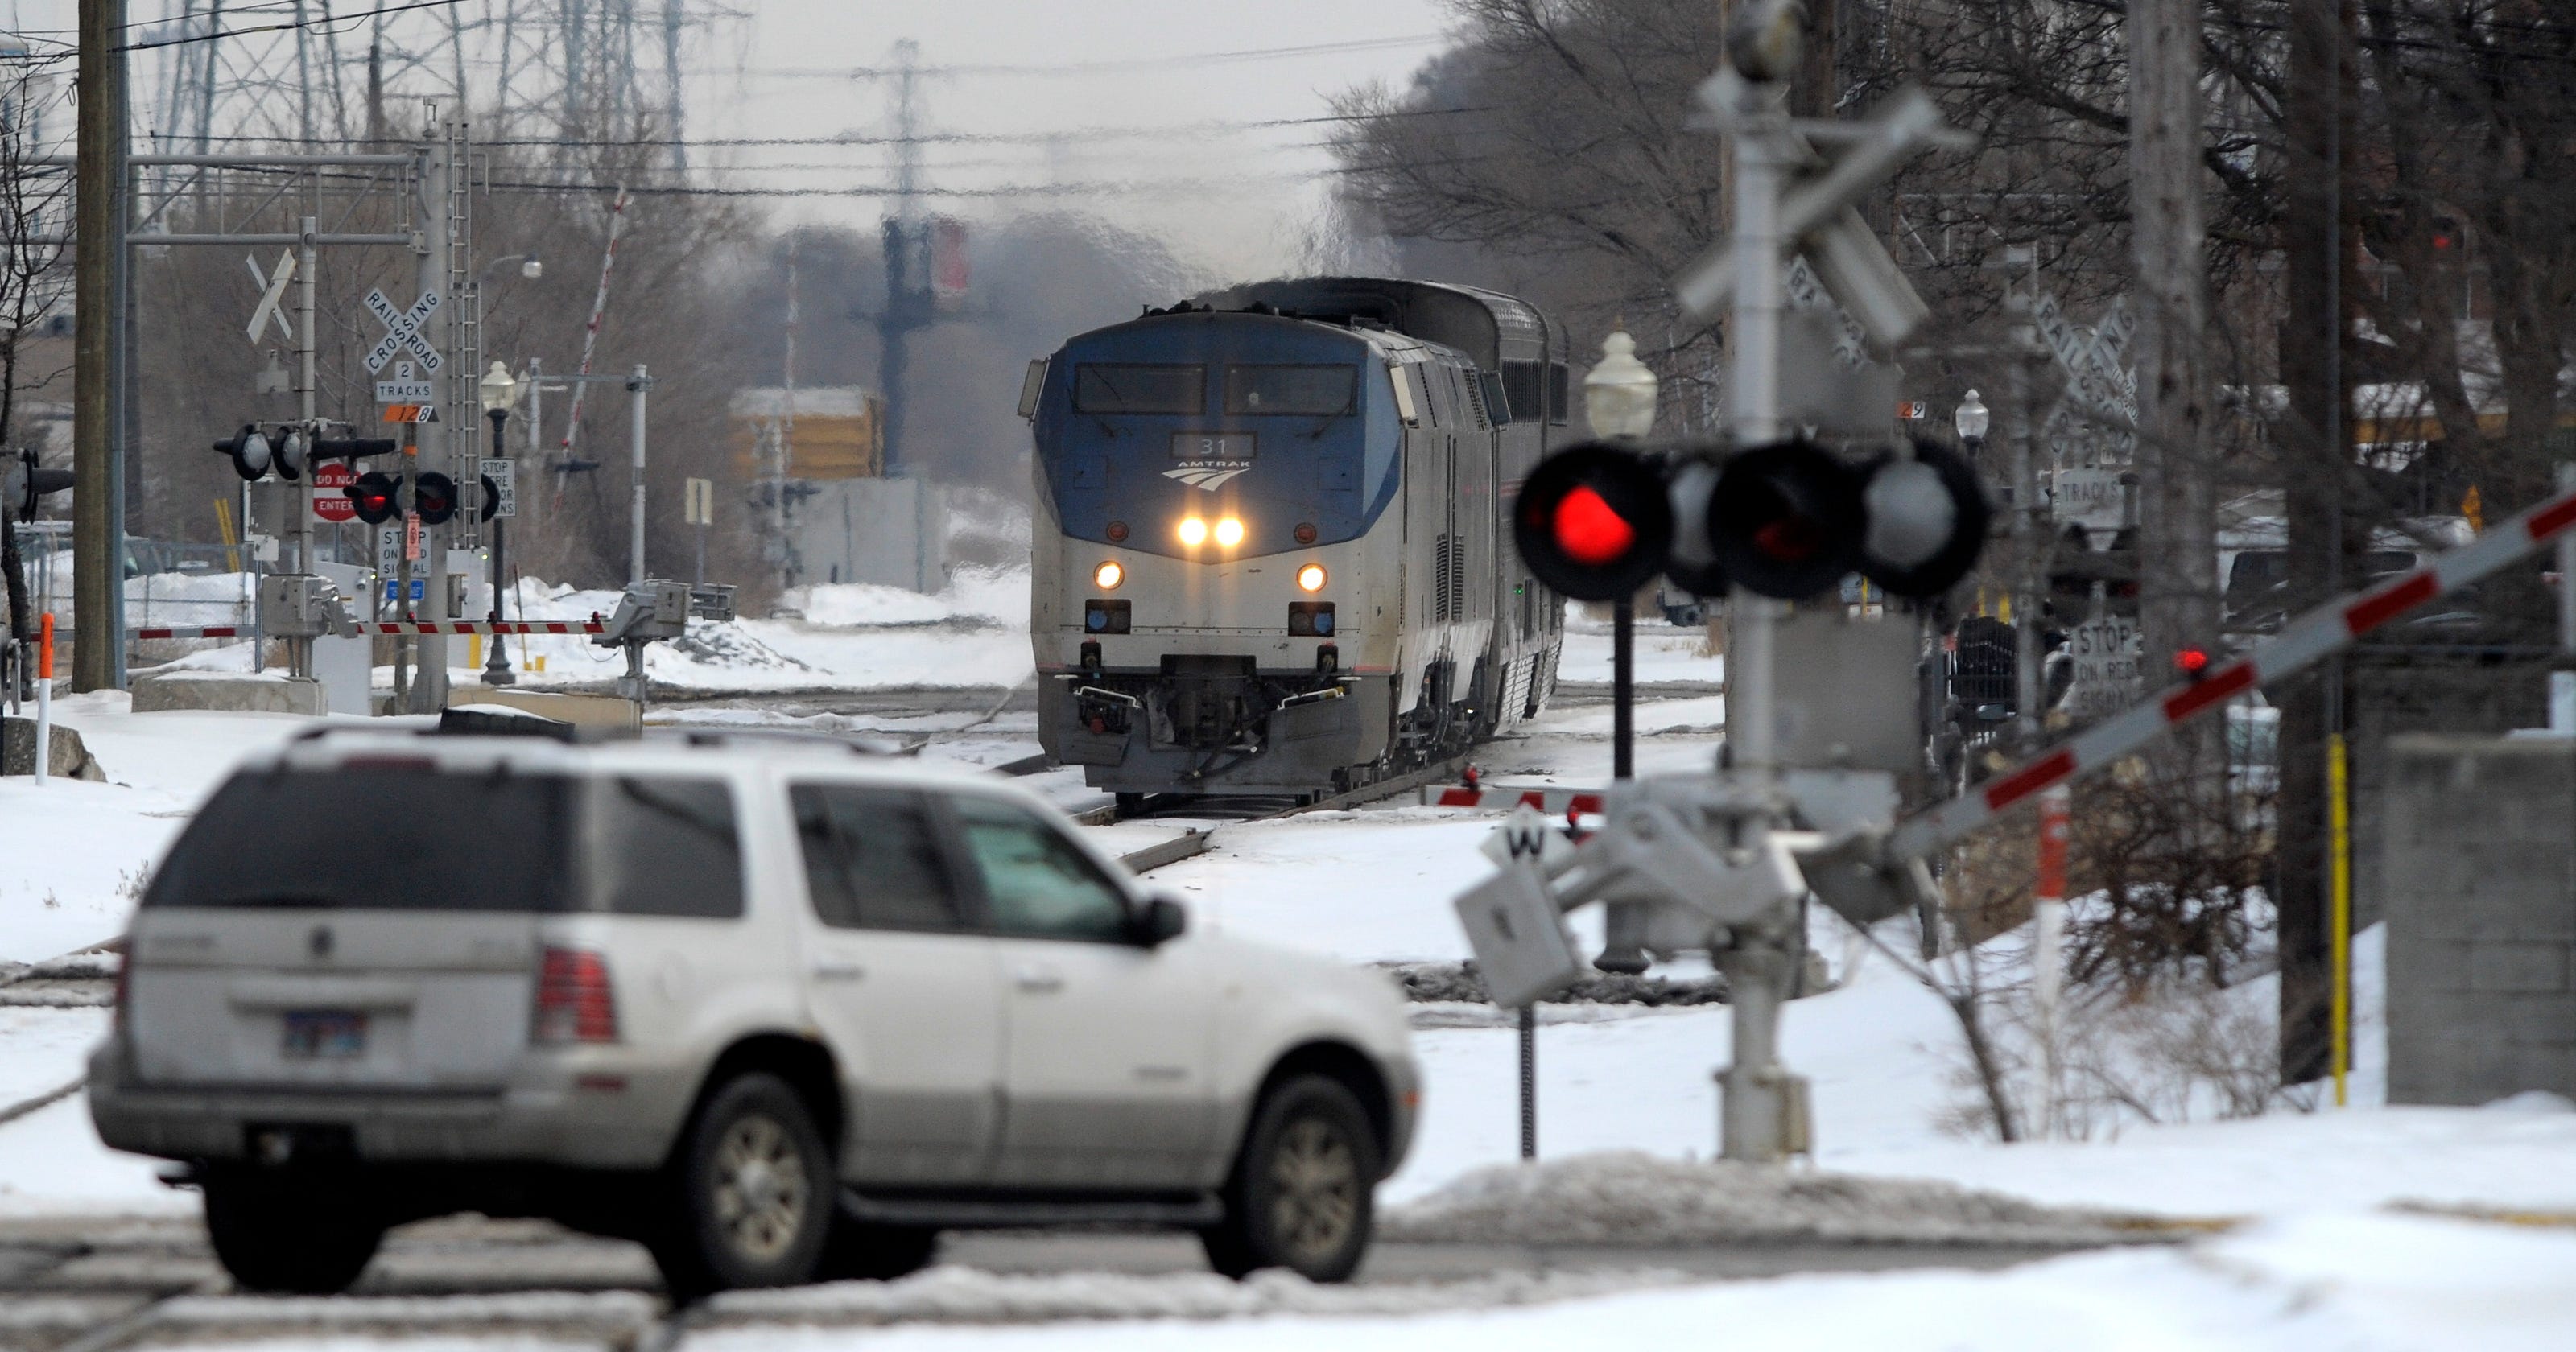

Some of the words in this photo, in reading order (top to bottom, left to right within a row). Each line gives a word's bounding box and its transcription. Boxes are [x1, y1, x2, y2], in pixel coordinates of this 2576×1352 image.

[368, 292, 398, 328] RAIL
[406, 334, 438, 369] ROAD
[368, 293, 438, 369] CROSSING
[2039, 301, 2079, 375] RAIL
[401, 365, 410, 377] 2
[380, 385, 431, 397] TRACKS
[398, 406, 430, 422] 128
[1200, 439, 1225, 455] 31
[483, 462, 508, 473] STOP
[317, 475, 332, 484] DO
[384, 531, 427, 545] STP
[383, 549, 398, 559] ON
[383, 564, 427, 575] SIAL
[2079, 626, 2131, 654] STOP
[1505, 827, 1546, 861] W
